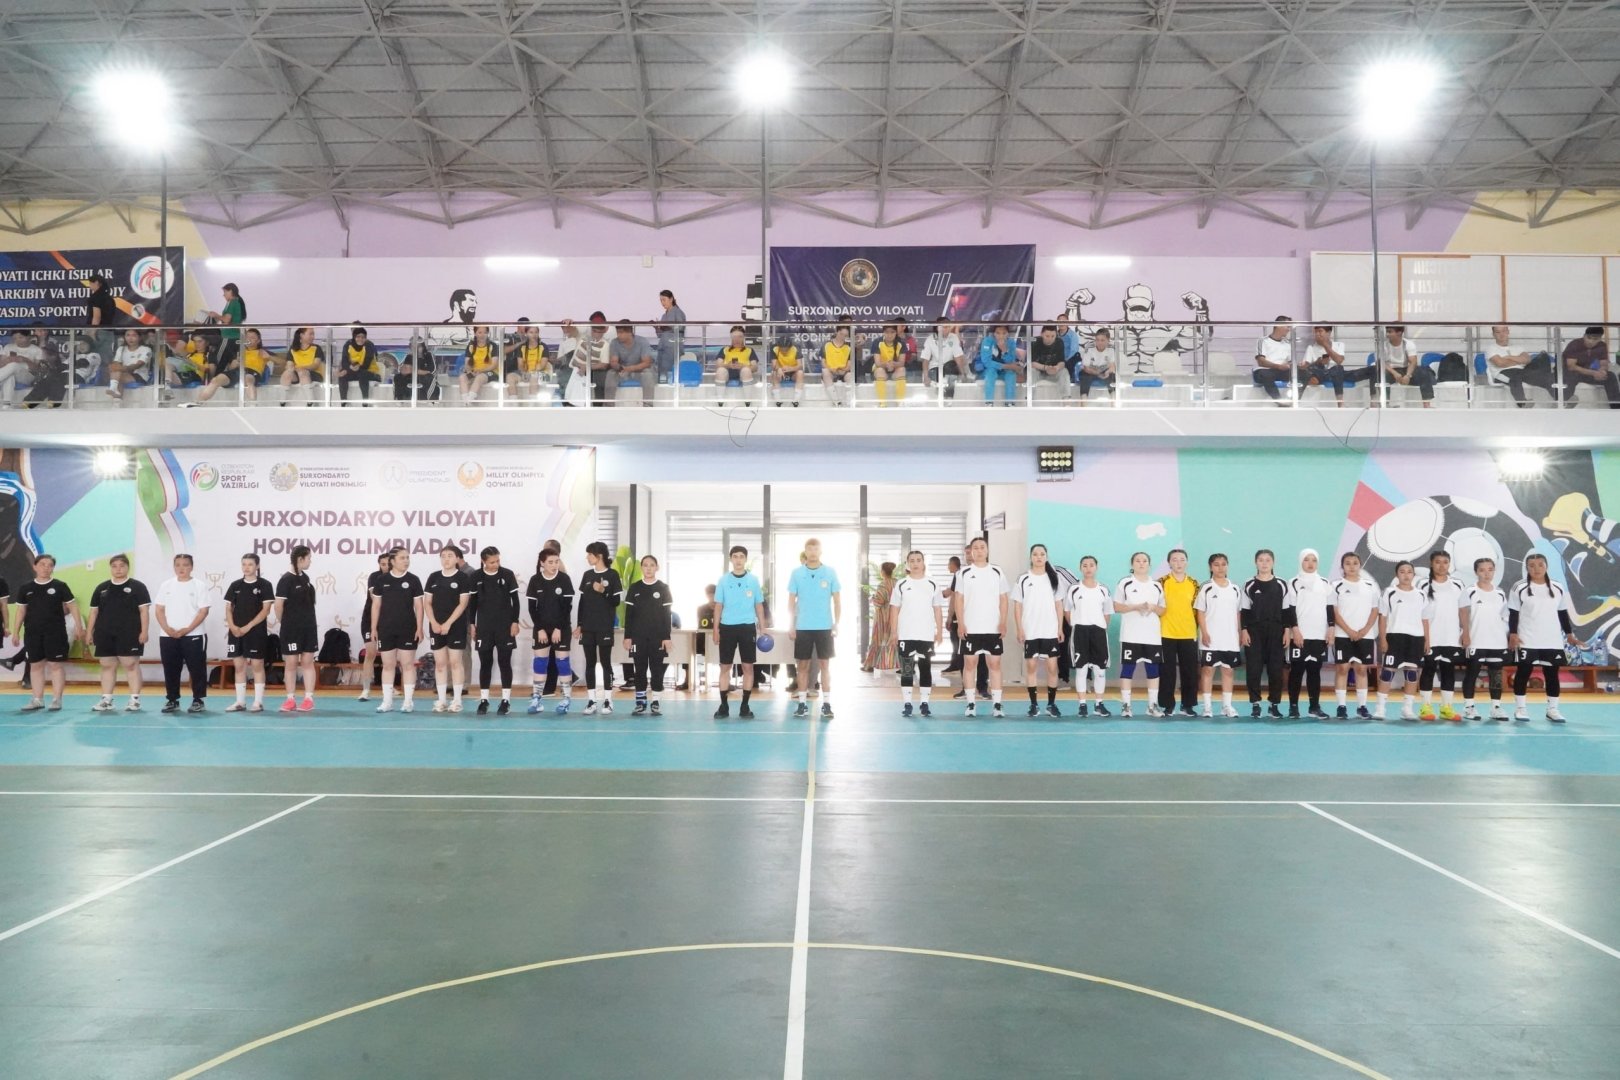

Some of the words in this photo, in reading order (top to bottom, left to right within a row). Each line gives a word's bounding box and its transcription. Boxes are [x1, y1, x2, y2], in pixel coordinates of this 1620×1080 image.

[0, 270, 28, 281] YATI
[31, 270, 65, 281] ICHKI
[50, 288, 64, 299] VA
[0, 307, 36, 318] ASIDA
[39, 306, 88, 317] SPORTN
[788, 305, 873, 316] SURXONDARYO
[875, 305, 924, 316] VILOYATI
[236, 510, 396, 527] SURXONDARYO
[402, 510, 496, 527] VILOYATI
[288, 643, 297, 652] 18
[900, 641, 906, 652] 9
[966, 641, 972, 652] 4
[1124, 650, 1133, 660] 12
[1206, 652, 1213, 662] 6
[1337, 650, 1343, 660] 11
[1386, 655, 1395, 666] 10
[1520, 650, 1527, 660] 3
